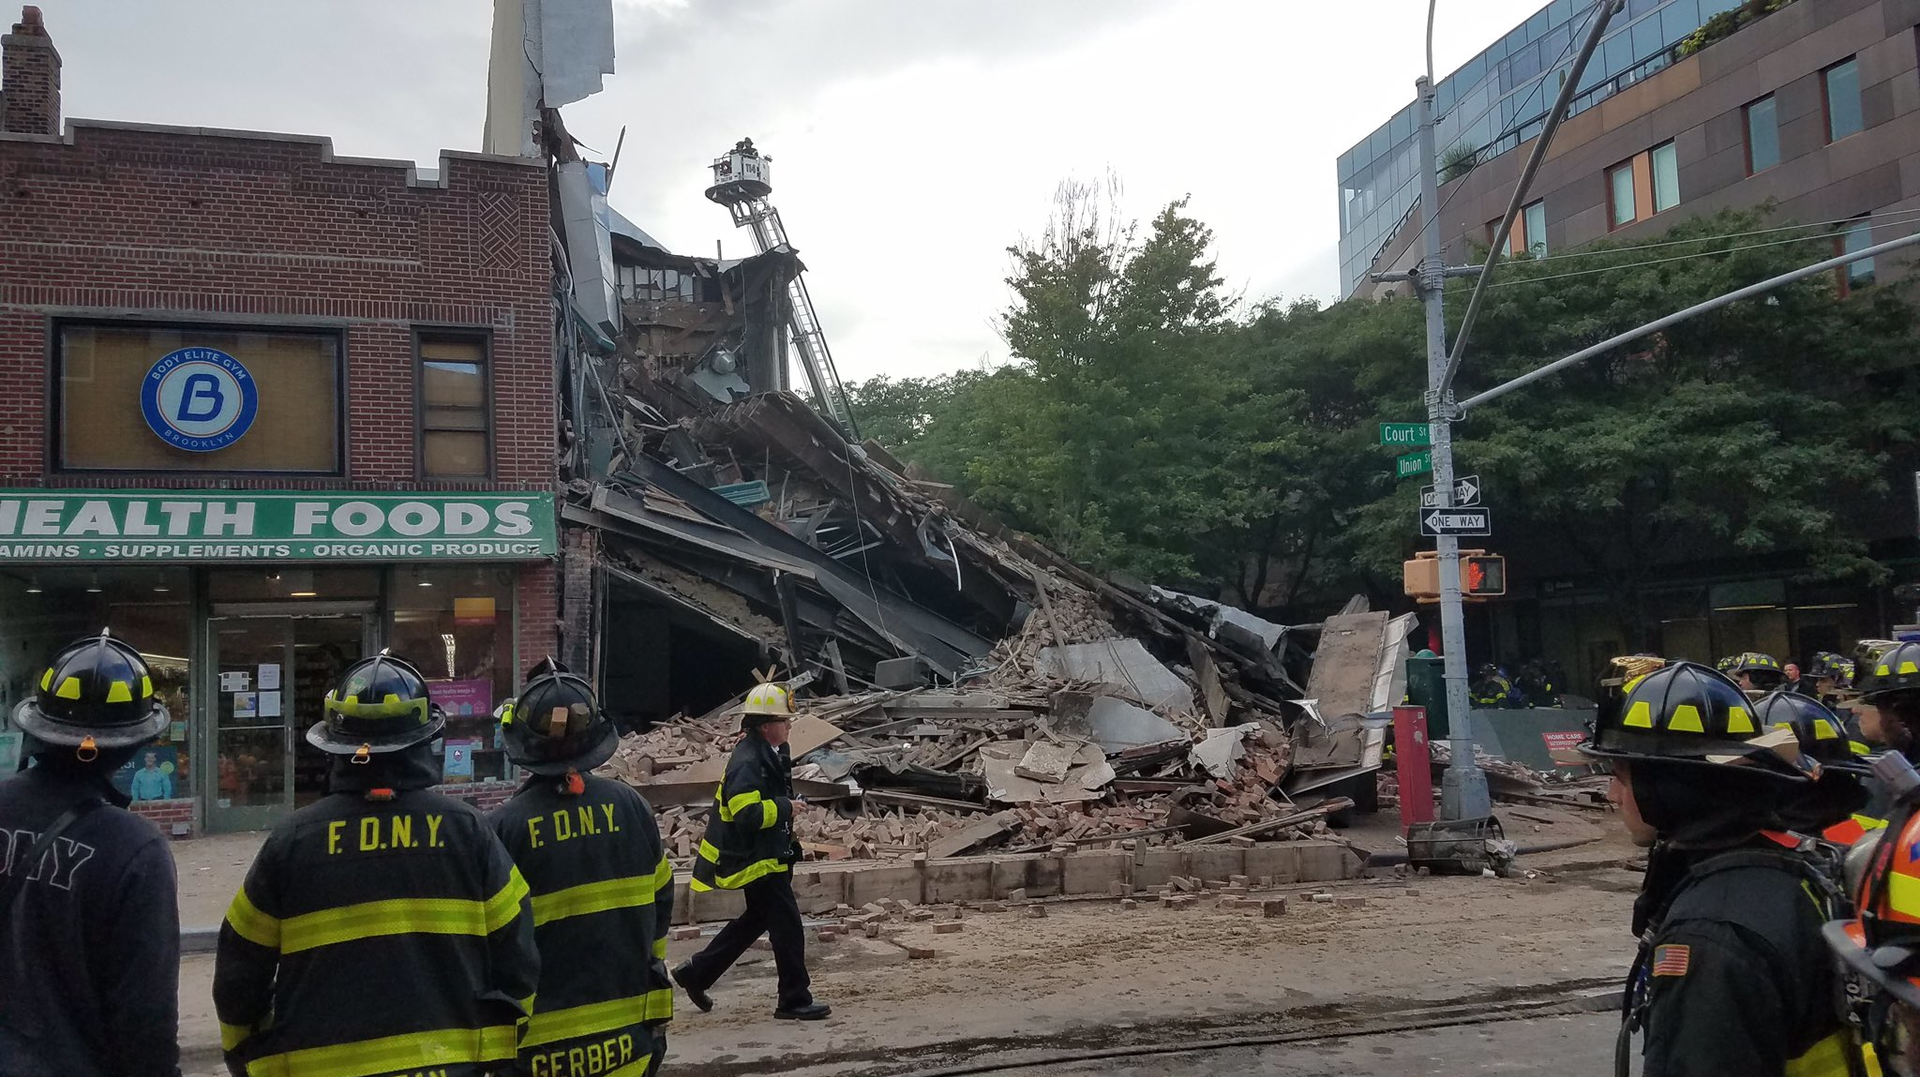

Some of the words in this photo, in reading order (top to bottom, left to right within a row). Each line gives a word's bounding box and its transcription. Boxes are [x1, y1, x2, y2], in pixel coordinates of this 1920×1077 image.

[151, 355, 180, 380] BODY
[184, 351, 220, 362] ELITE
[223, 359, 246, 380] GYM
[176, 373, 225, 422] B
[164, 429, 234, 448] BROOKLYN
[1385, 426, 1415, 441] Court
[1419, 426, 1427, 437] St
[1400, 457, 1422, 475] Union
[293, 502, 534, 536] FOODS
[1431, 516, 1451, 527] ONE
[1460, 516, 1480, 527] WAY
[104, 544, 290, 558] SUPPLEMENTS
[313, 544, 423, 557] ORGANIC
[531, 1033, 633, 1077] GERBER
